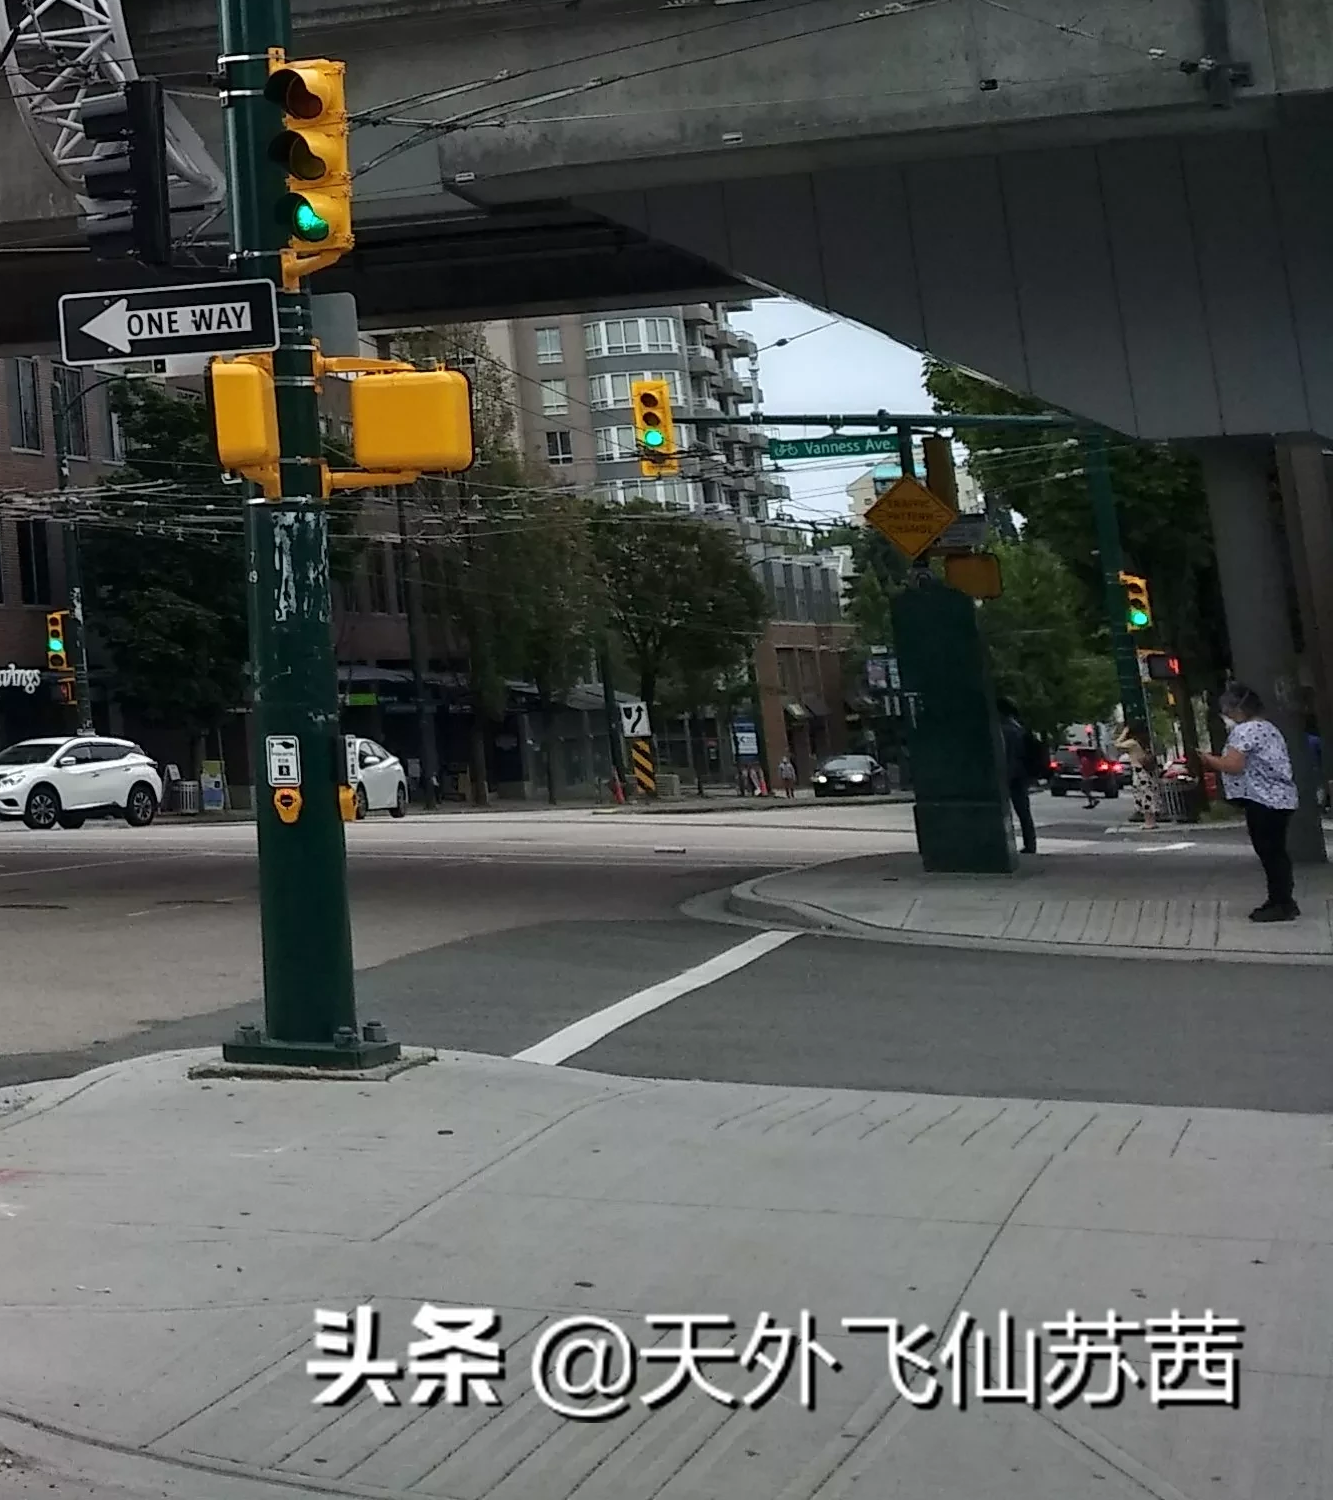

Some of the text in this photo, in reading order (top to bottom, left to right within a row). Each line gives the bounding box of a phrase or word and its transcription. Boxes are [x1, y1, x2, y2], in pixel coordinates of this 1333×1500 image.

[127, 305, 246, 337] ONE WAY
[803, 437, 895, 456] Vanness Ave.
